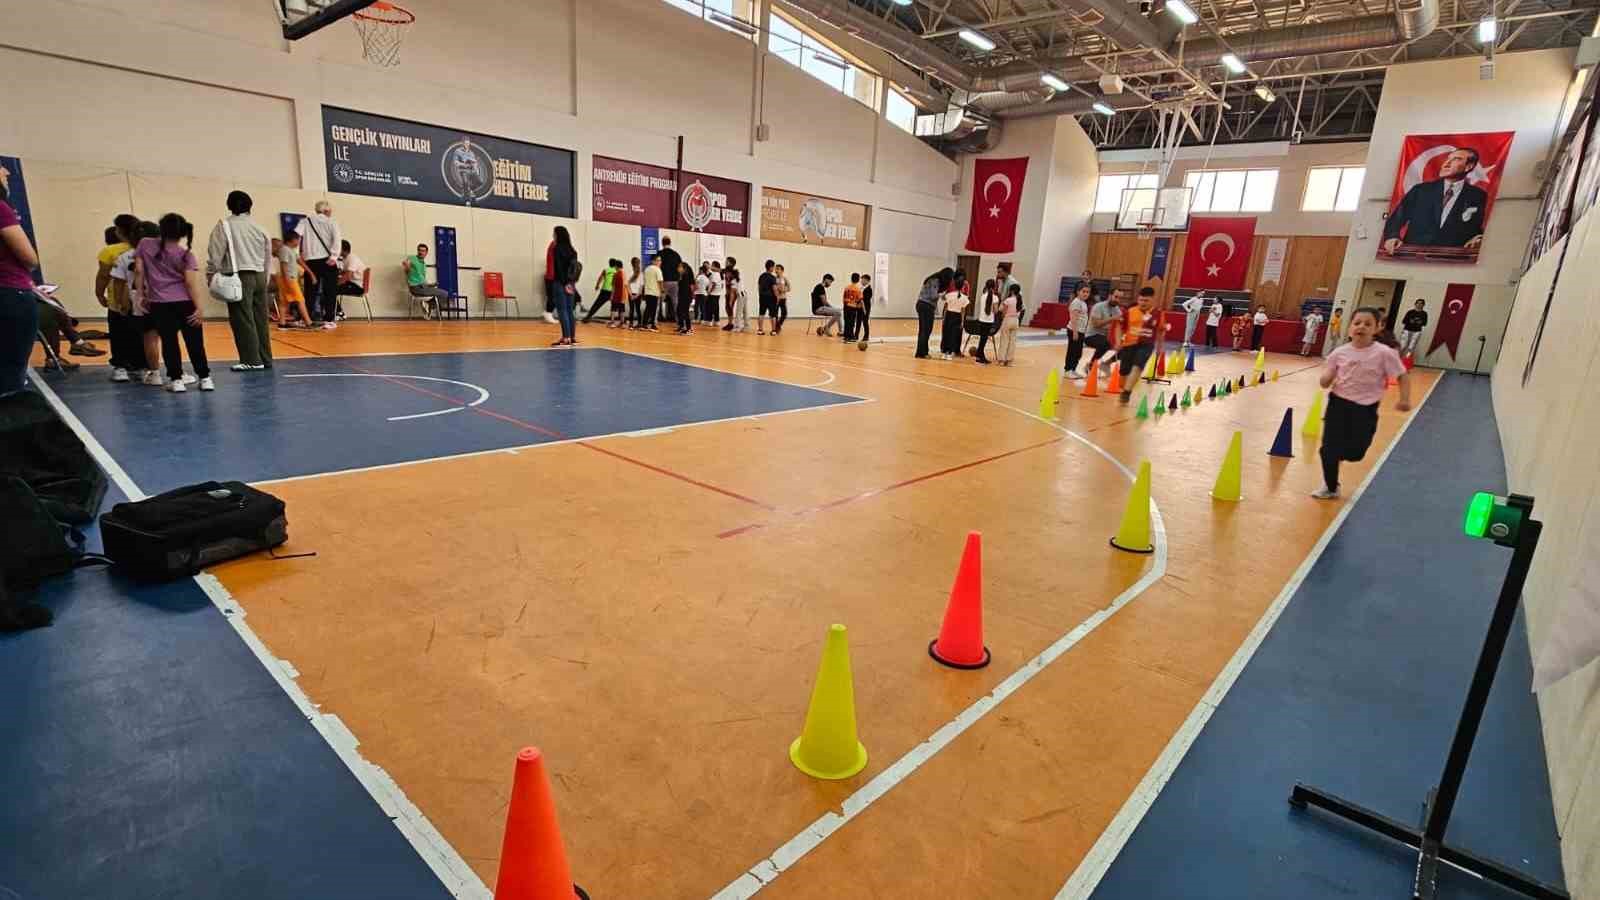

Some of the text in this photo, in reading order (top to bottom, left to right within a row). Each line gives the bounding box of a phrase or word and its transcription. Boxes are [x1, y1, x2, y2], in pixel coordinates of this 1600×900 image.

[331, 124, 431, 154] GENÇLİK YAYINLARI
[516, 182, 549, 202] YERDE
